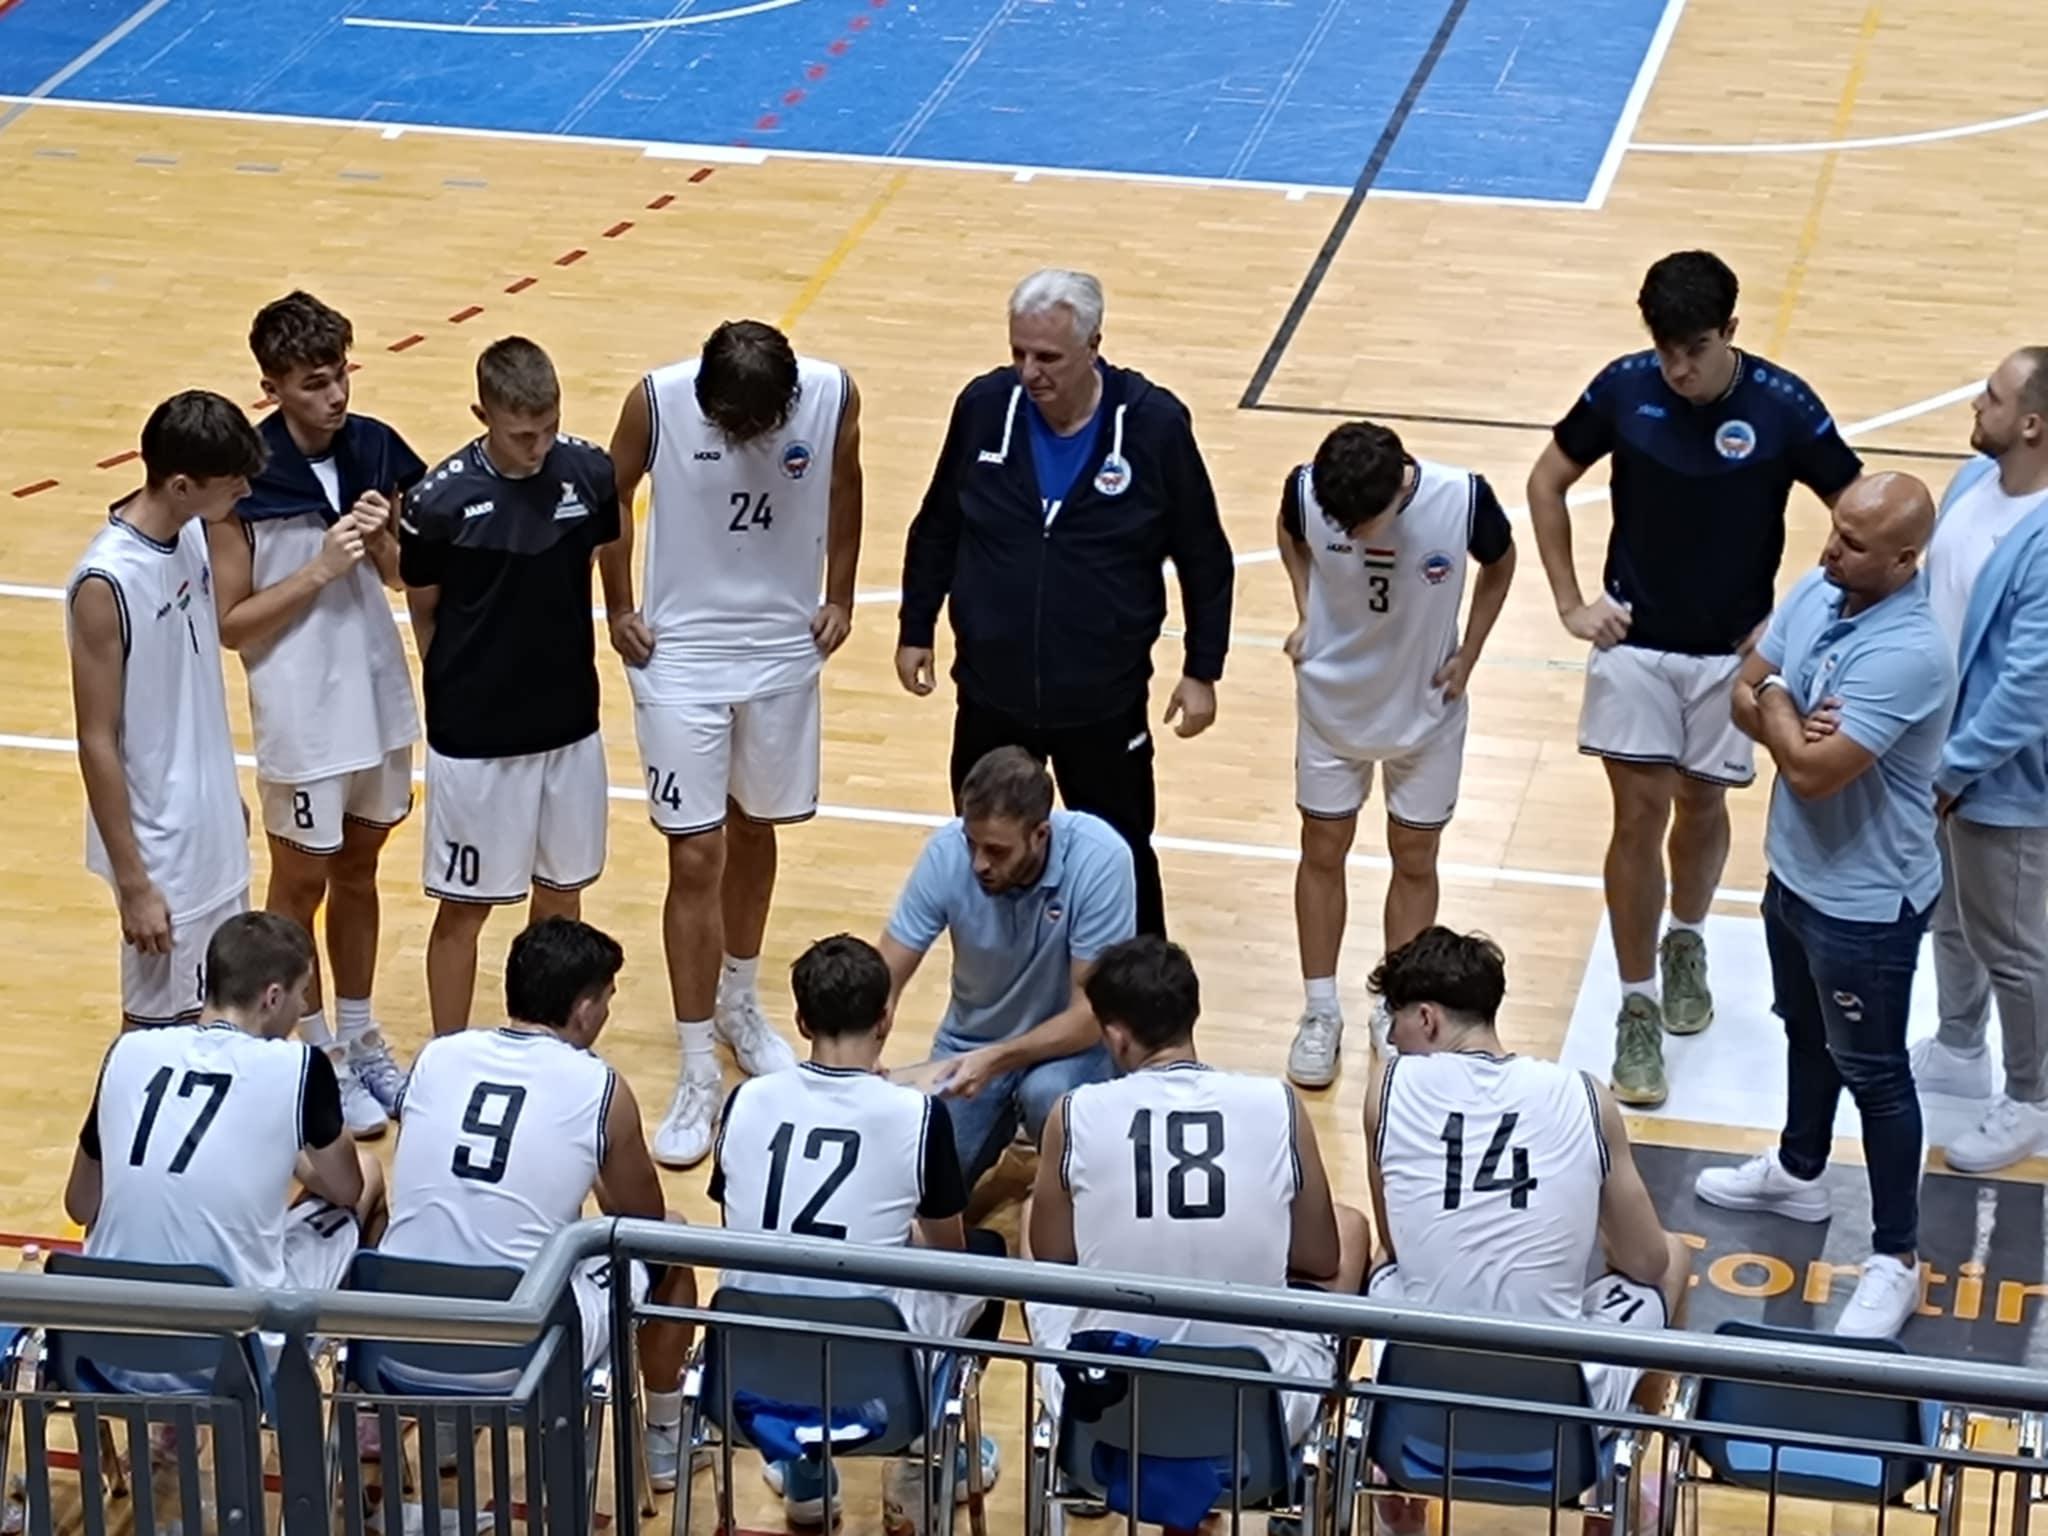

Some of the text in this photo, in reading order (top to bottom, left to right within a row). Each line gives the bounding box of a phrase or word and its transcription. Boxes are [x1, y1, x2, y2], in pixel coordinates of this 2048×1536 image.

[729, 492, 773, 532] 24
[1368, 576, 1389, 613] 3
[293, 791, 314, 829] 8
[648, 766, 682, 811] 24
[445, 840, 479, 887] 70
[129, 1065, 232, 1174] 17
[451, 1081, 526, 1184] 9
[761, 1121, 861, 1241] 12
[1127, 1108, 1226, 1220] 18
[1439, 1111, 1537, 1210] 14
[1601, 1283, 1645, 1324] 14
